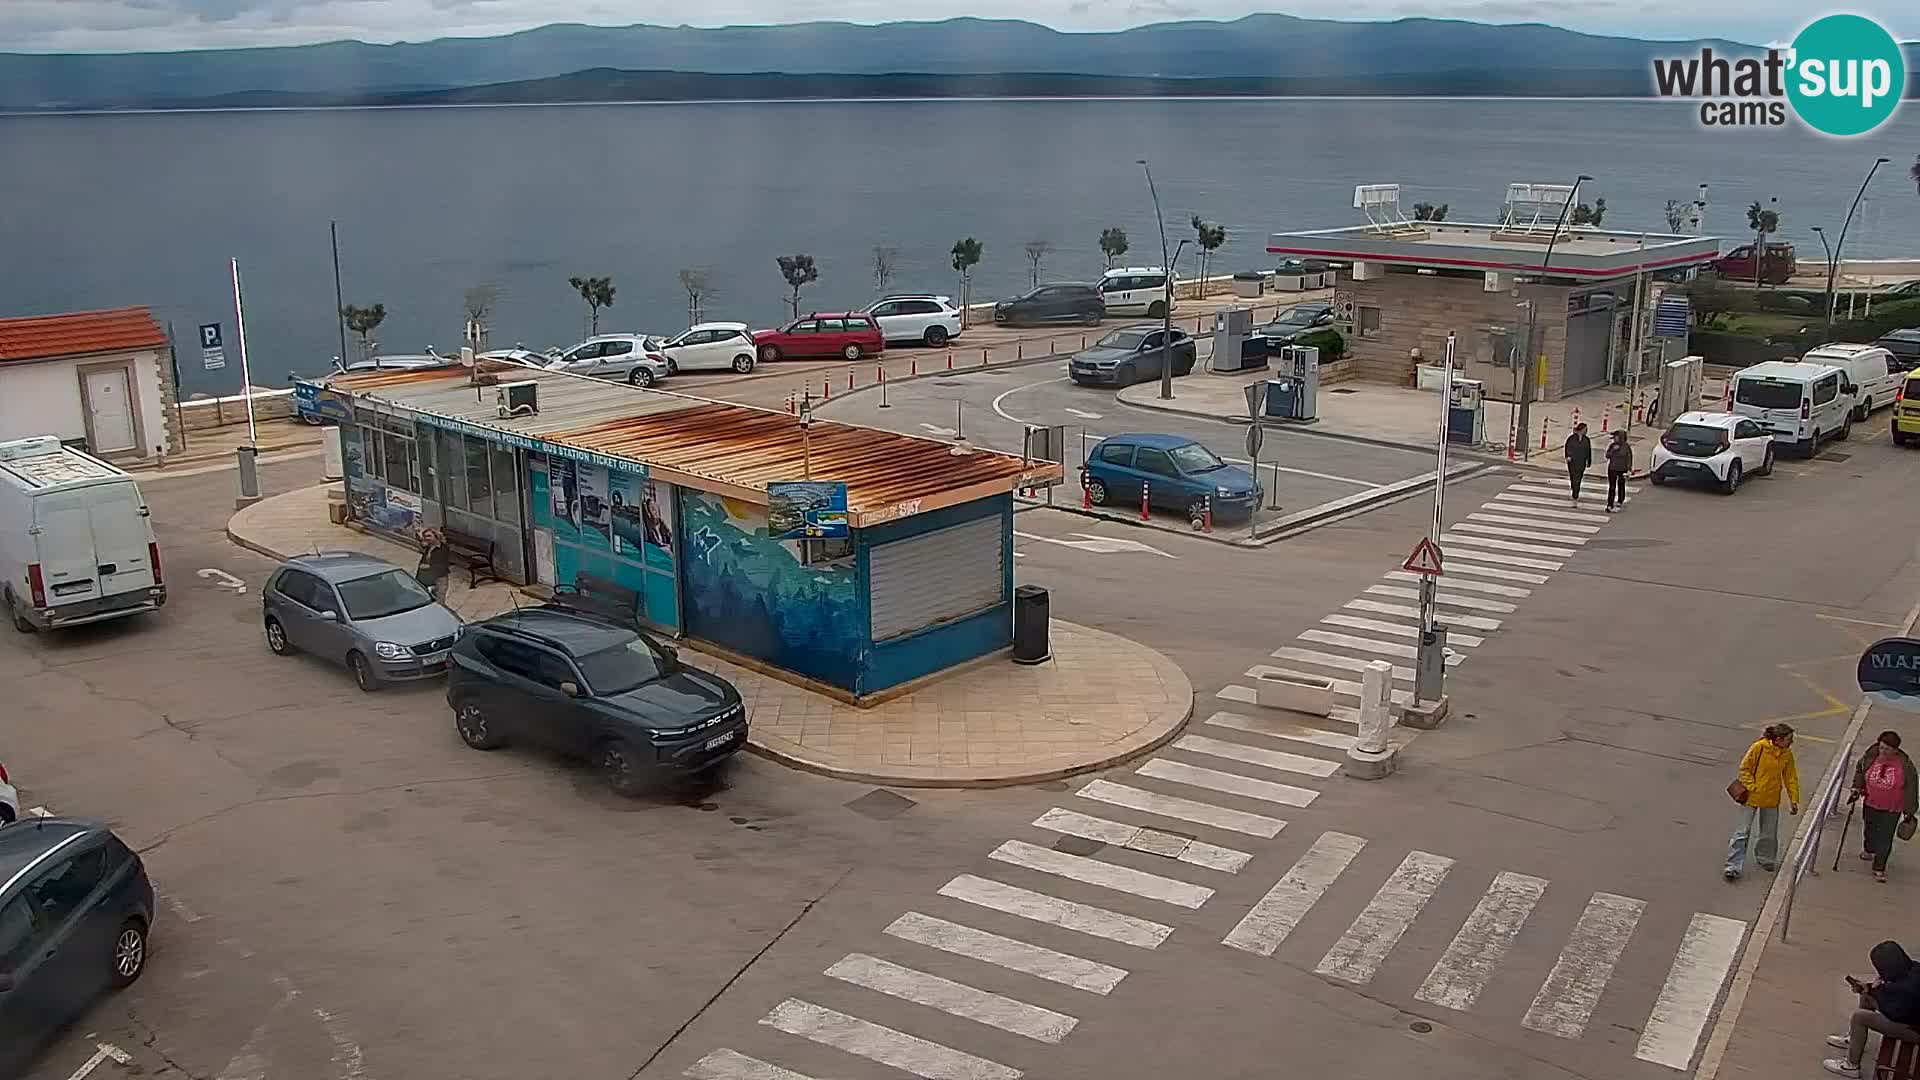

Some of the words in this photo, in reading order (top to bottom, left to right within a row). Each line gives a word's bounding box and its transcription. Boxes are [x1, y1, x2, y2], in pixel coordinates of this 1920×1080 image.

[204, 327, 216, 345] P
[542, 443, 557, 454] BUS
[559, 446, 590, 462] STATION
[592, 454, 617, 468] TICKET
[619, 460, 645, 474] OFFICE
